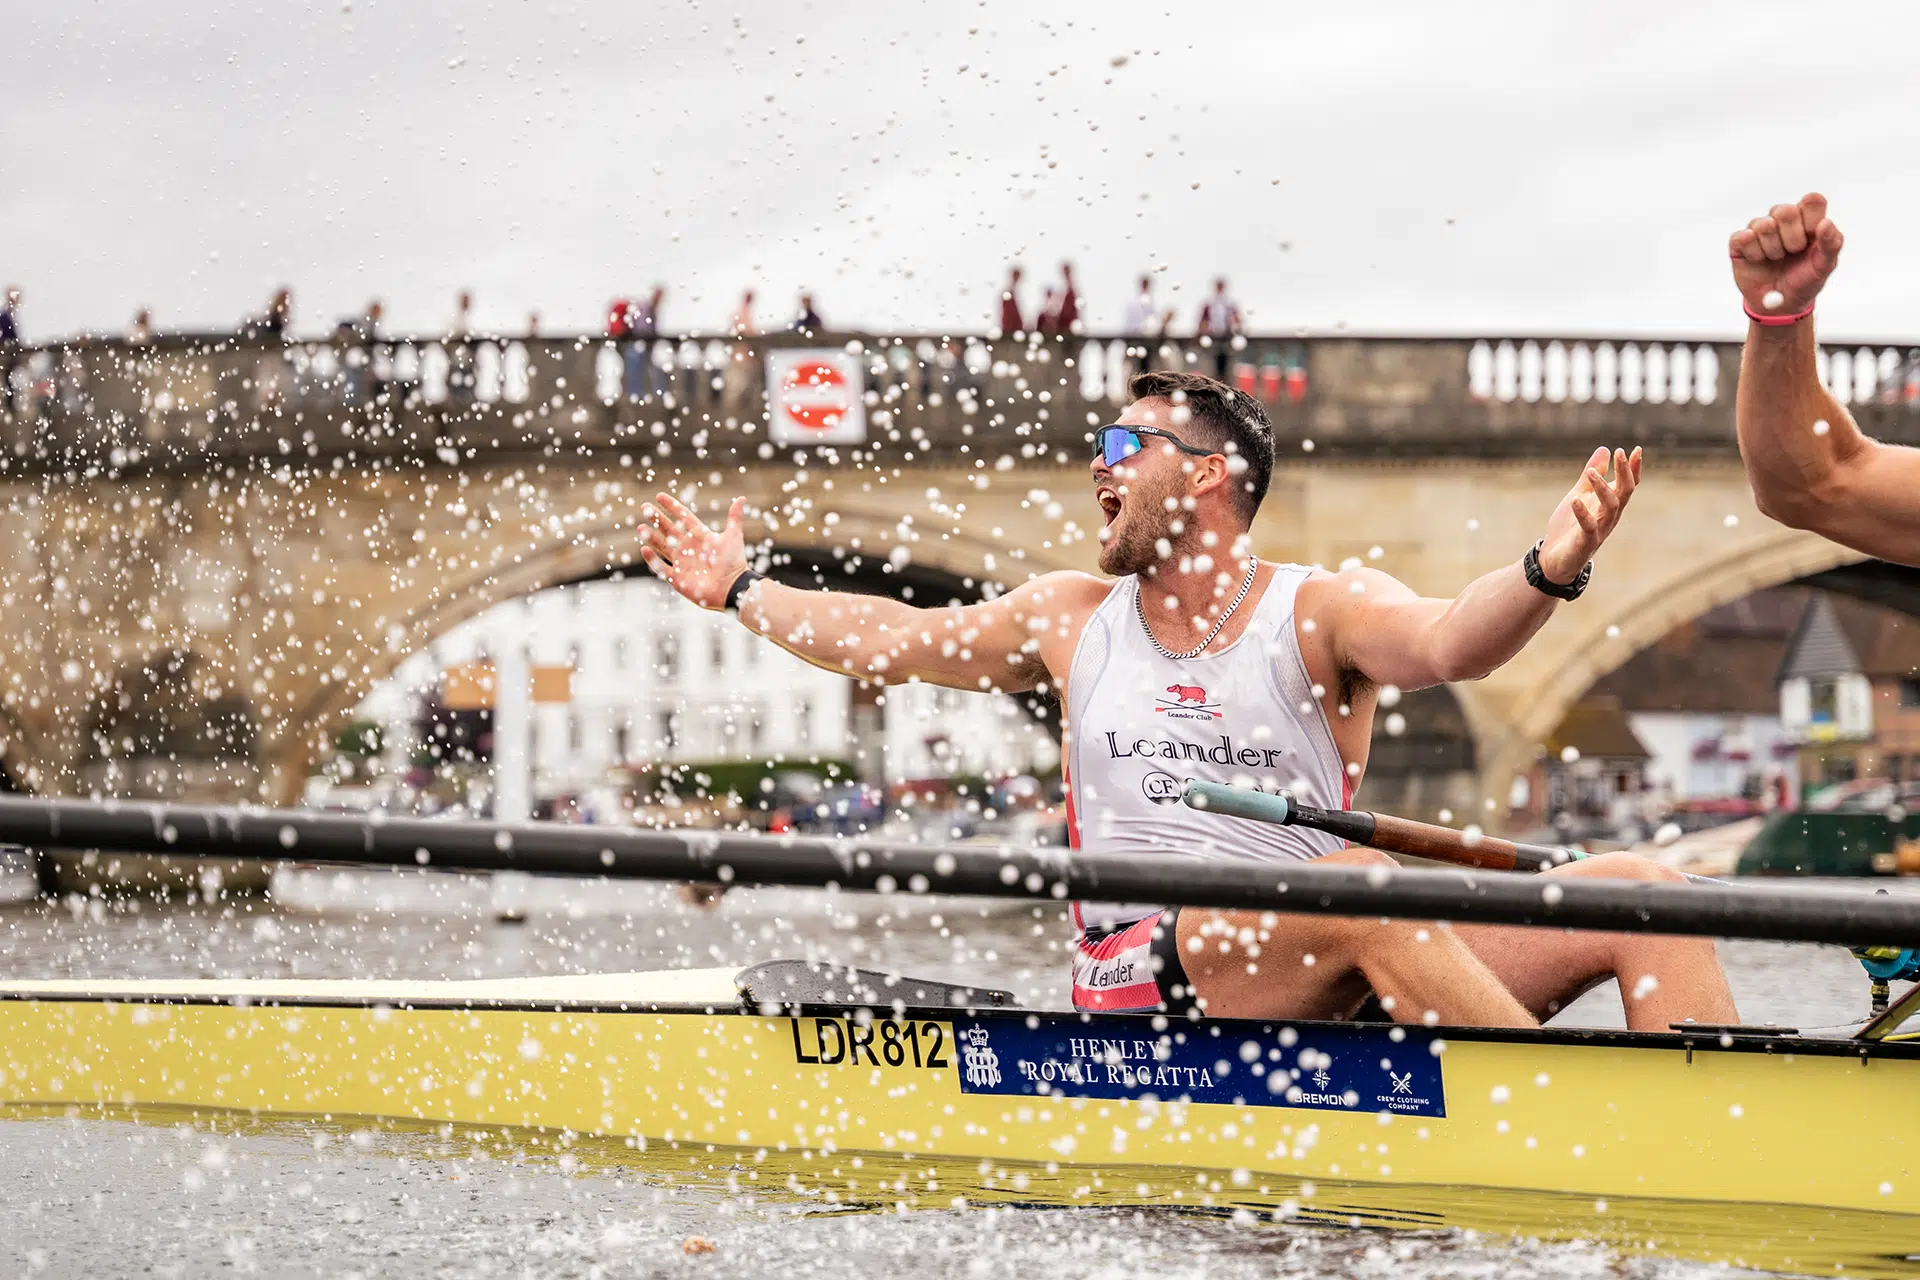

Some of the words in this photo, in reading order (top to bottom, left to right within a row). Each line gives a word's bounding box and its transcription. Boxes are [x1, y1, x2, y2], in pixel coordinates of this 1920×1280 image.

[1105, 731, 1282, 768] Leander
[1149, 779, 1173, 795] CF
[791, 1018, 948, 1068] LDR812
[1069, 1038, 1161, 1060] HENLEY
[1026, 1061, 1099, 1083] ROYAL
[1106, 1064, 1214, 1088] REGATTA
[1295, 1092, 1354, 1106] BREMON
[1388, 1102, 1420, 1110] COMPANY
[1397, 1096, 1430, 1105] CLOTHING
